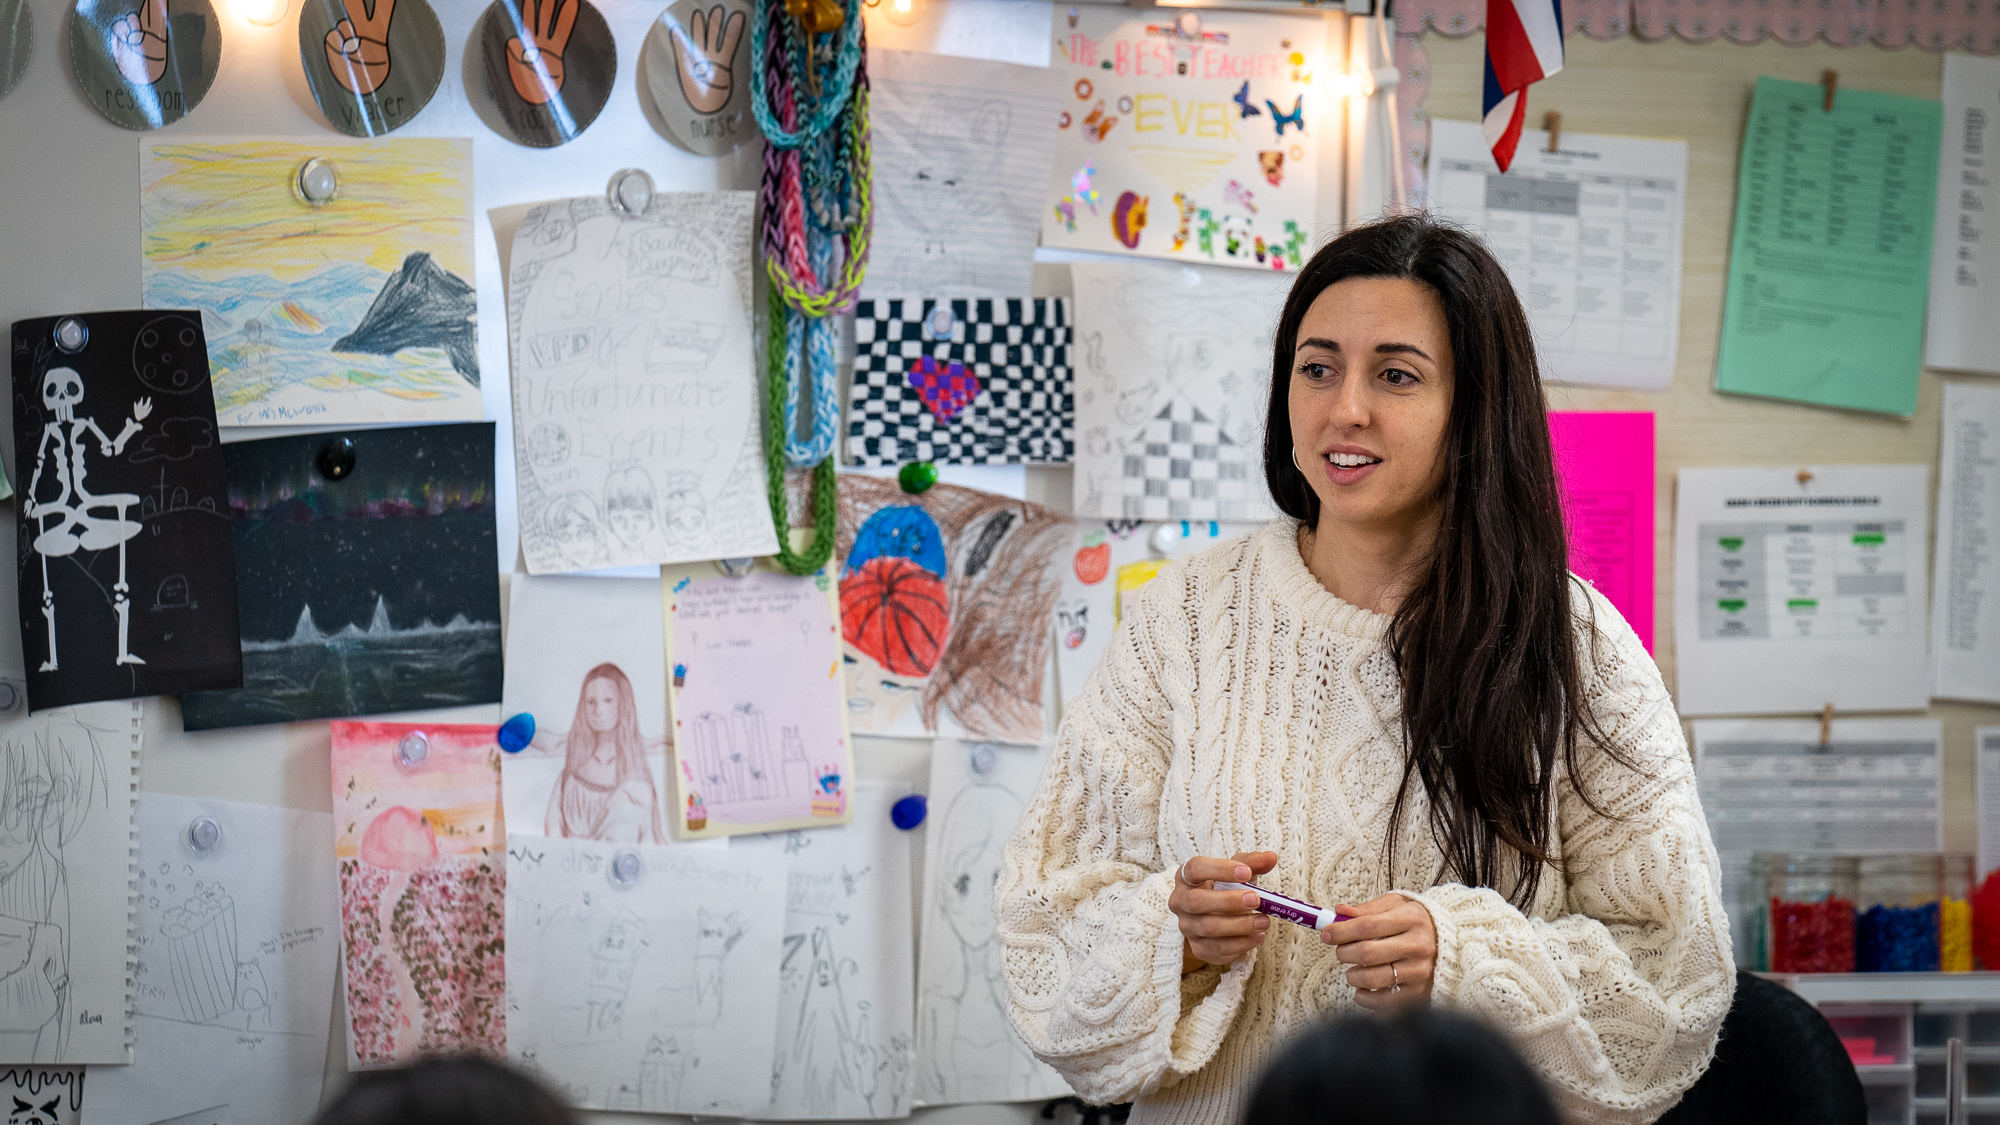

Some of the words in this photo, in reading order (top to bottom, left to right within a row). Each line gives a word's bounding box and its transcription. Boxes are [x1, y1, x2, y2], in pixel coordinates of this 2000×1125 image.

[1114, 39, 1178, 79] BEST
[689, 114, 738, 139] nurse
[1134, 93, 1242, 143] EVER
[552, 270, 672, 320] Series
[525, 370, 732, 419] Unfortunate
[1269, 904, 1287, 915] erase
[1286, 908, 1298, 919] dry
